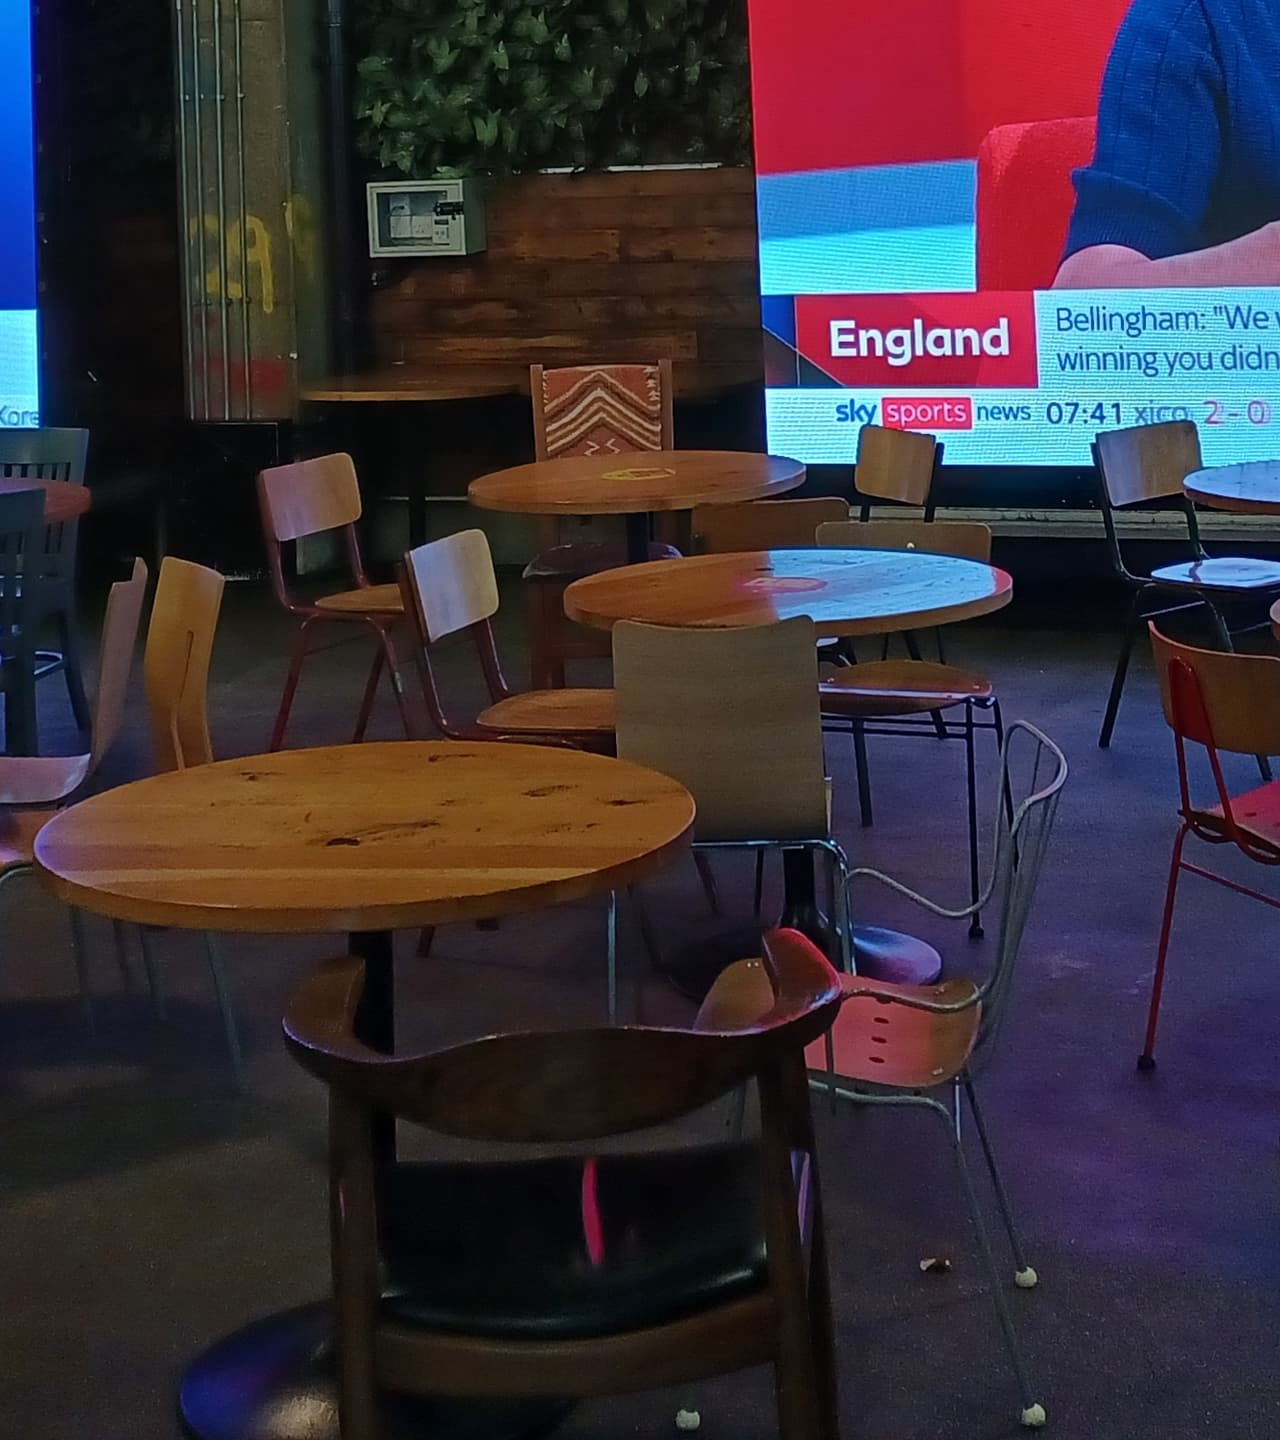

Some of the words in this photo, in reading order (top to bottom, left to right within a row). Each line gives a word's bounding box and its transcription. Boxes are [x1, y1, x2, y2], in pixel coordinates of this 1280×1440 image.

[1056, 307, 1207, 335] Bellingham:
[1213, 305, 1270, 329] "We
[829, 318, 1009, 366] England
[1056, 345, 1159, 376] winning
[1167, 350, 1214, 376] you
[836, 400, 878, 425] sky
[886, 401, 968, 426] sports
[977, 404, 1032, 421] news
[1046, 401, 1122, 425] 07:41
